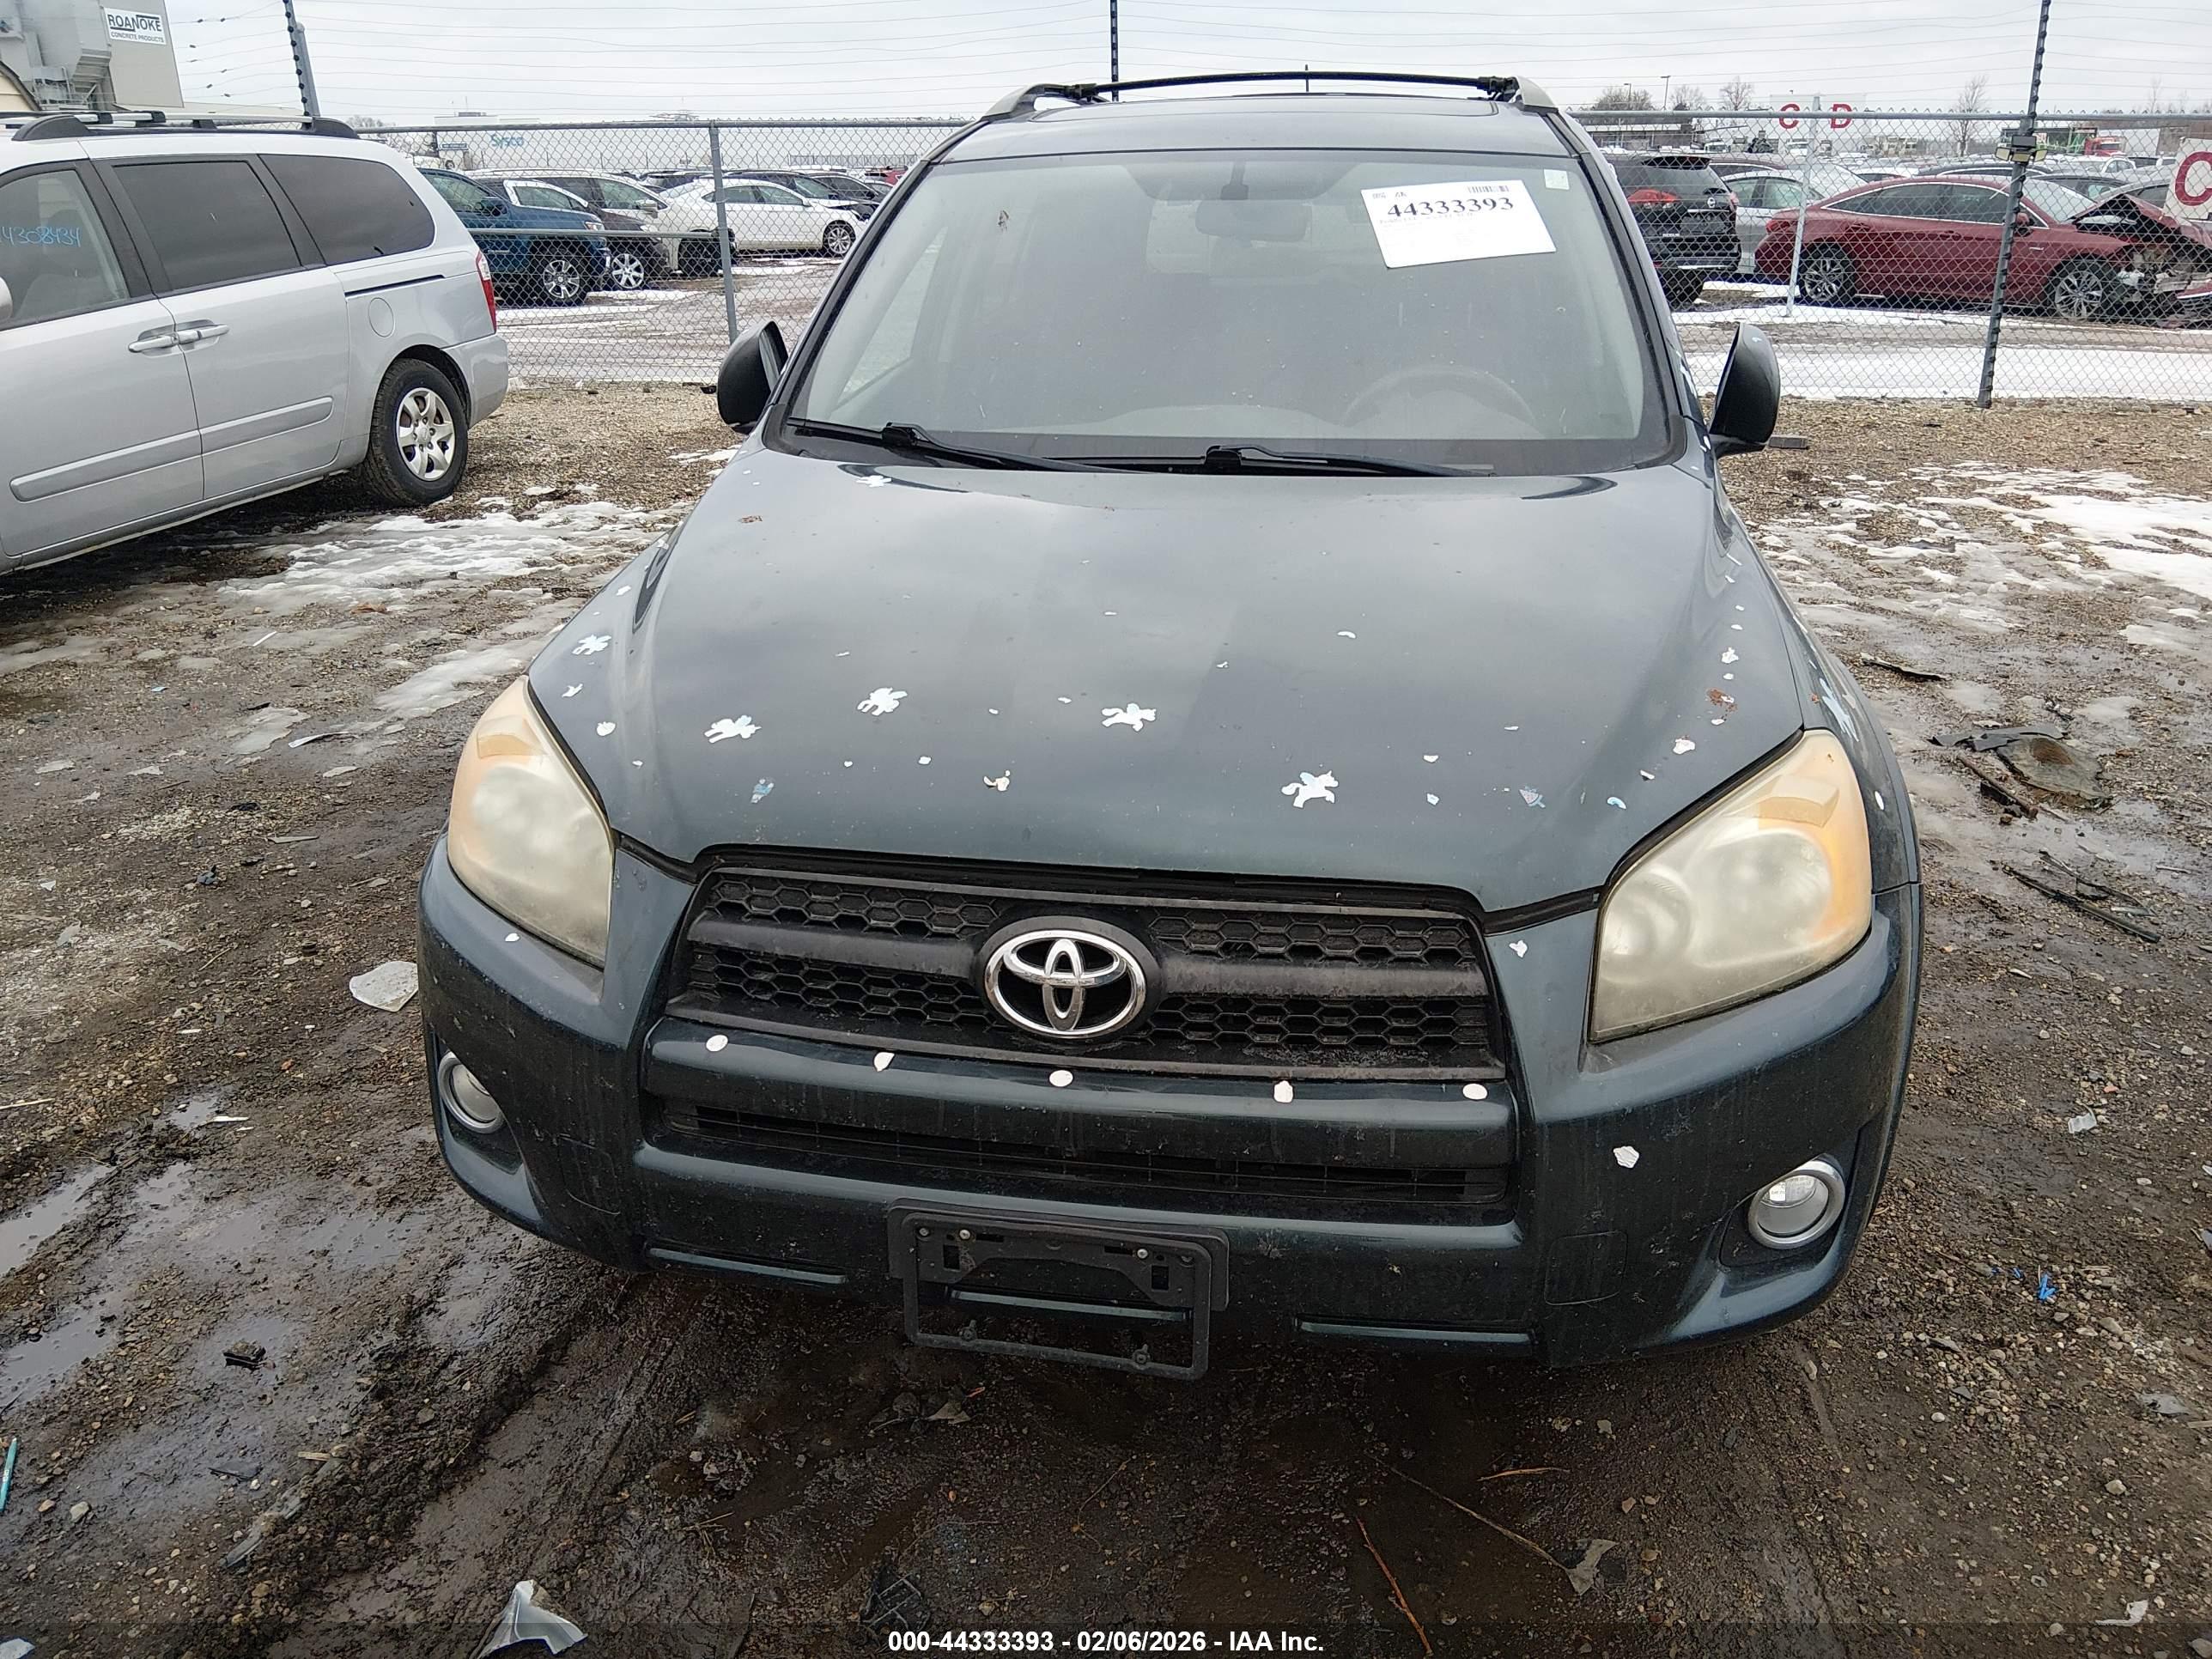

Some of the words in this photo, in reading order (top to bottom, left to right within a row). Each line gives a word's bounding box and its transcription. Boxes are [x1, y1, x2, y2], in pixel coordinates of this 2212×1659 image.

[107, 14, 162, 32] ROANOKE
[111, 31, 137, 40] CONCRETE
[138, 34, 164, 43] PRODUCTS
[1778, 103, 1801, 129] C
[1830, 103, 1853, 129] D
[491, 134, 524, 149] Sysco
[1388, 197, 1515, 218] 44333393
